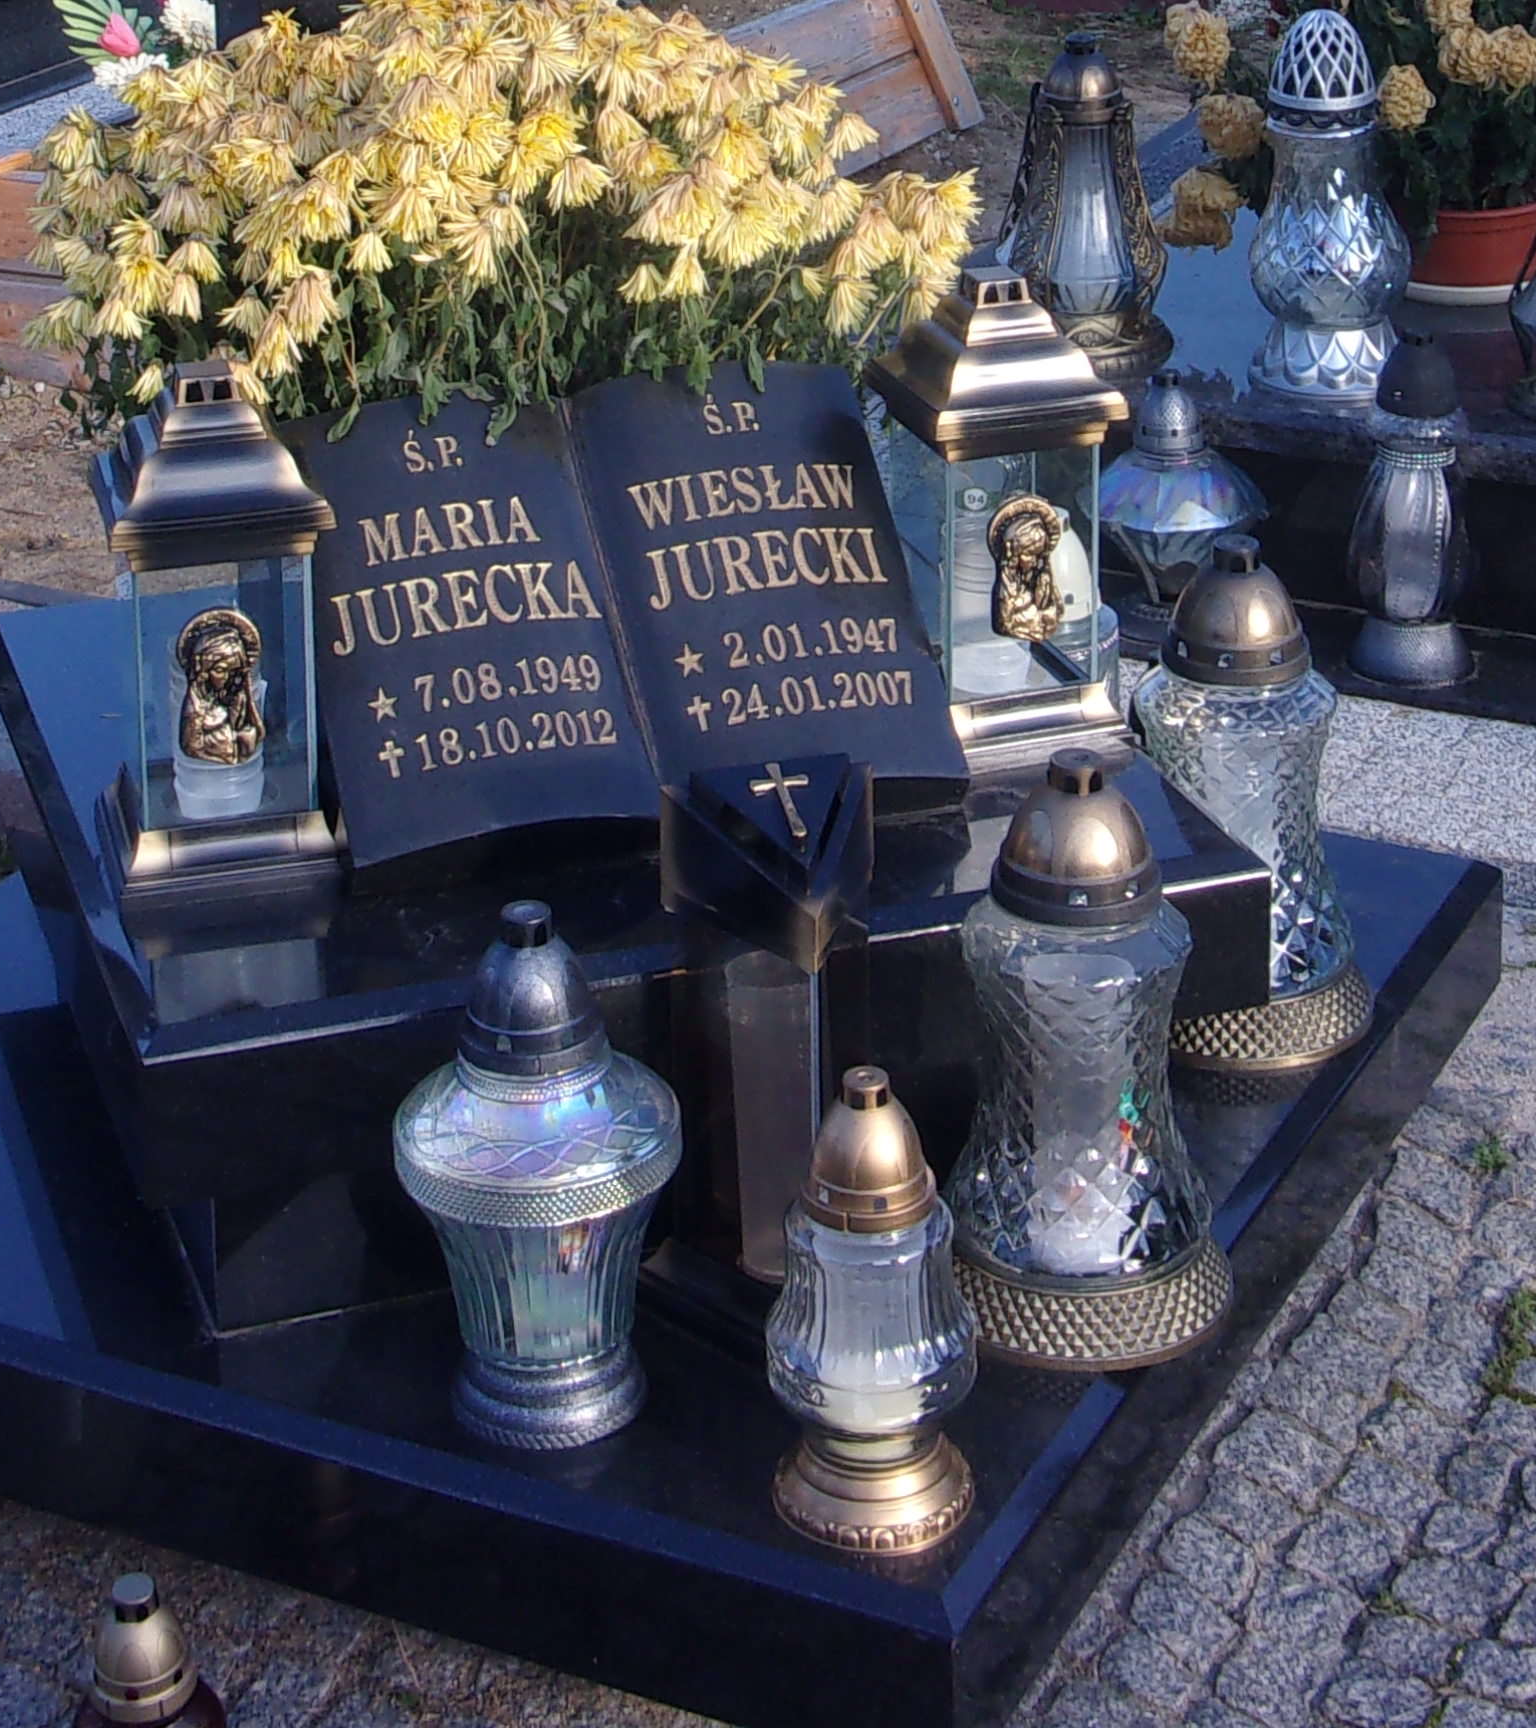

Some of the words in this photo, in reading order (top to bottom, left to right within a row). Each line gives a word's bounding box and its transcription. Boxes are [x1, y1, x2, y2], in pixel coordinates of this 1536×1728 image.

[626, 463, 855, 531] WIESŁAW
[358, 495, 541, 567] MARIA
[646, 527, 890, 611] JURECKI
[331, 561, 603, 658] JURECKA
[723, 617, 899, 670] 2.01.1947
[414, 654, 603, 713] 7.08.1949
[721, 671, 915, 727] 24.01.2007
[415, 709, 618, 773] 18.10.2012
